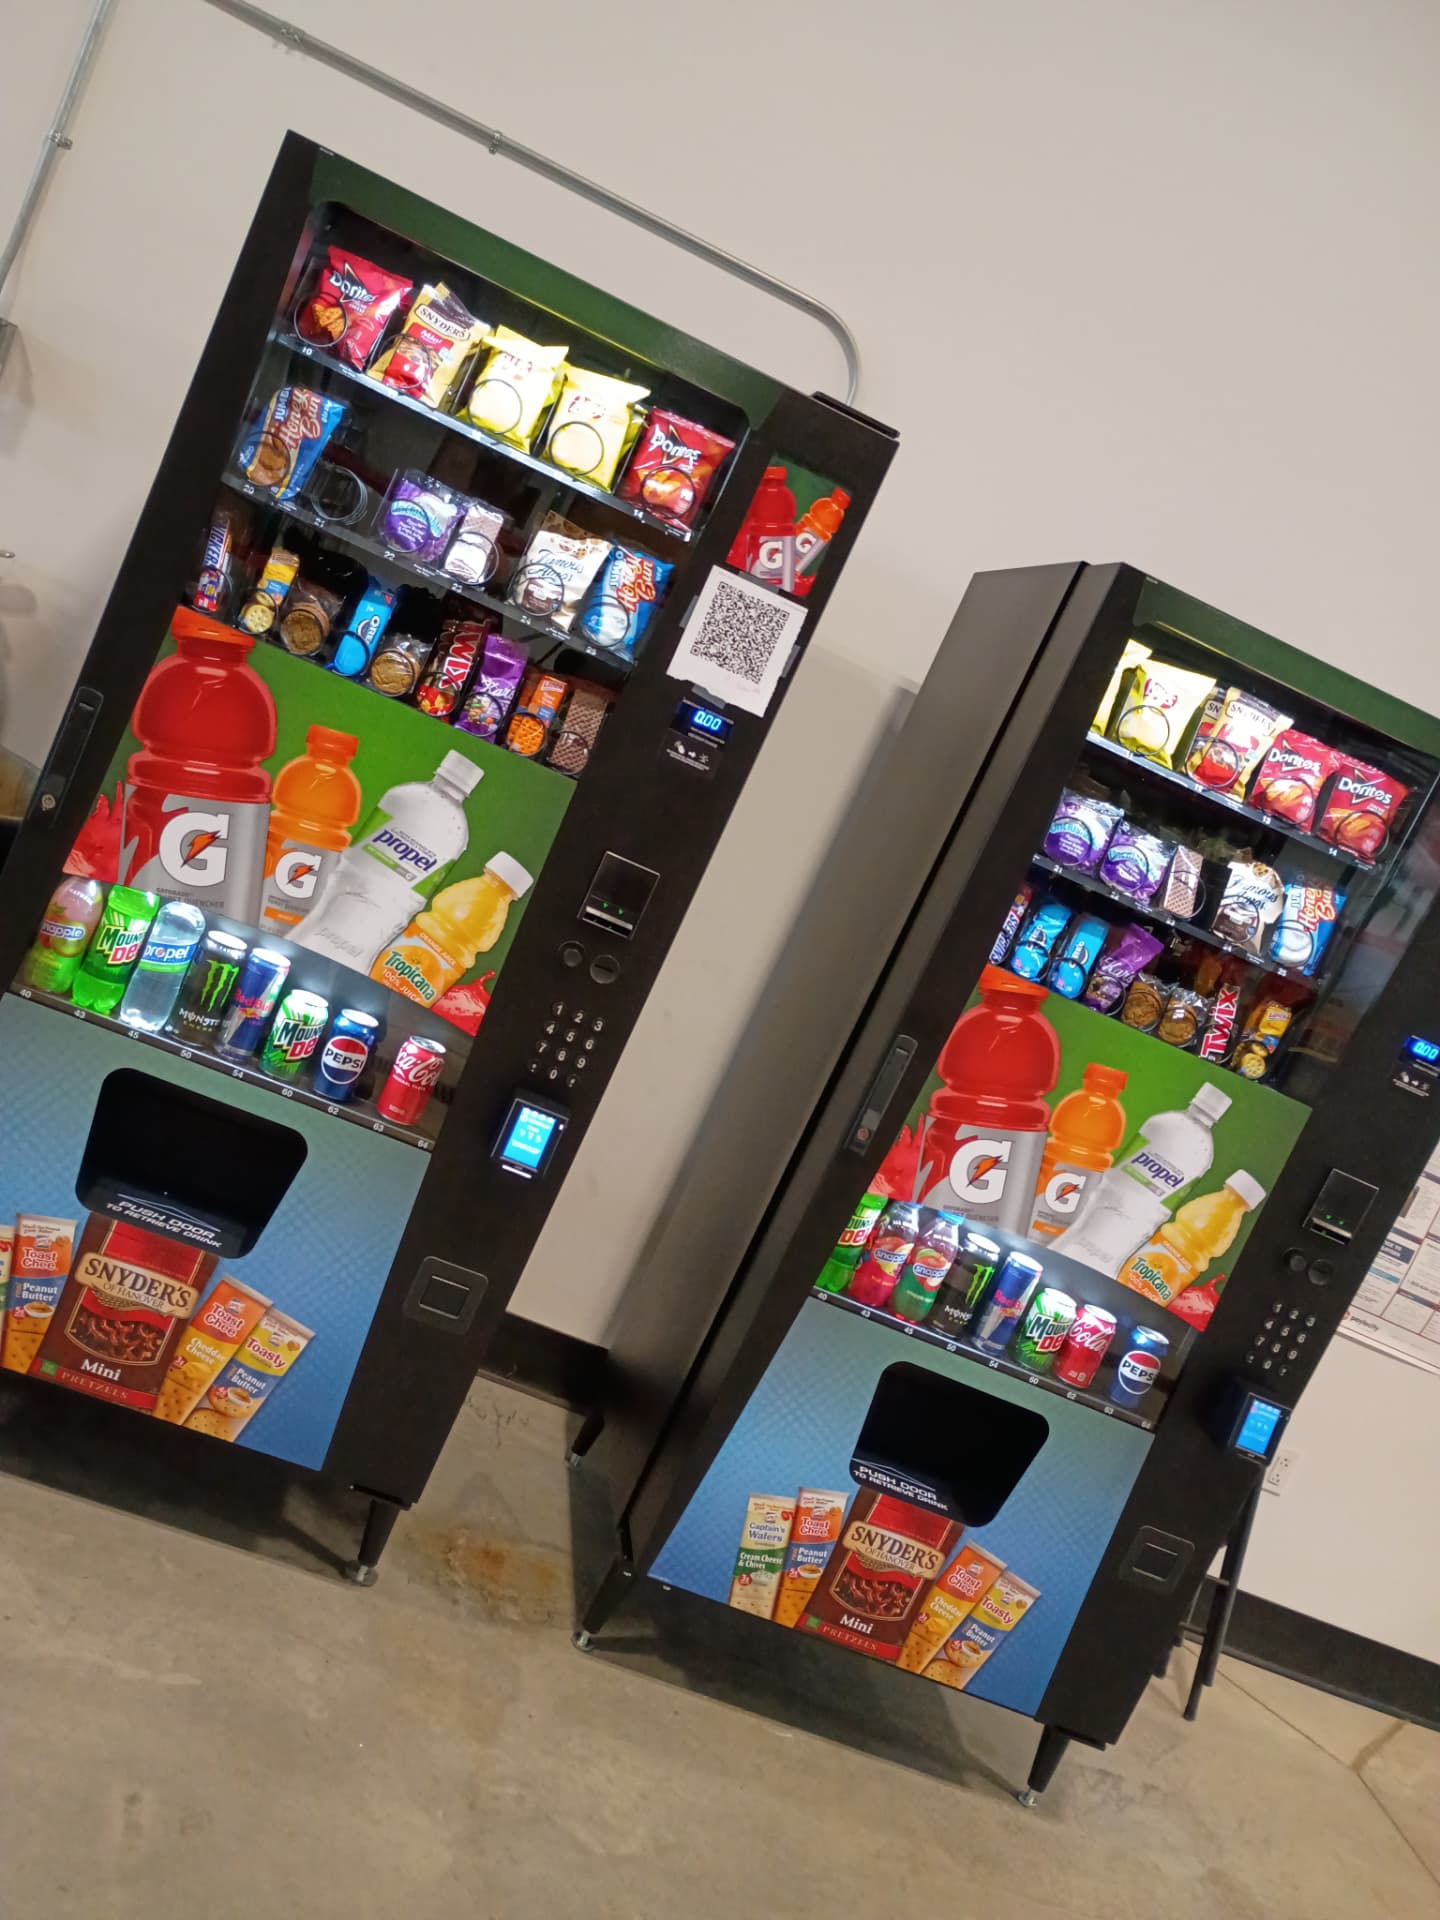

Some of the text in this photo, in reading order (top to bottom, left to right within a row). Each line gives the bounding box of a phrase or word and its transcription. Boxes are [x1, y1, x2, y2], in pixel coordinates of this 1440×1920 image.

[302, 346, 313, 355] 10
[279, 387, 311, 446] Honey
[300, 396, 322, 438] Bun
[795, 531, 817, 554] G
[384, 551, 395, 561] 22
[530, 548, 585, 574] Famous
[759, 540, 784, 569] G
[616, 553, 643, 611] Honey
[634, 560, 656, 601] Bun
[365, 615, 380, 645] ORE
[694, 710, 722, 730] 0.00
[1268, 747, 1321, 776] Doritos
[1338, 776, 1392, 805] Doritos
[159, 812, 230, 887] G
[372, 829, 437, 872] propel
[275, 851, 321, 899] G
[1229, 875, 1279, 903] Famous
[41, 922, 84, 939] napple
[144, 943, 189, 962] propel
[384, 950, 436, 1001] Tropicana
[19, 989, 32, 999] 40
[74, 1009, 87, 1020] 43
[556, 1004, 603, 1031] 1 2 3
[1200, 987, 1239, 1057] TWIX
[128, 1030, 140, 1040] 45
[546, 1024, 594, 1050] 4 5 6
[180, 1050, 192, 1060] 50
[326, 1047, 364, 1069] PEPSI
[539, 1042, 586, 1068] 7 8 9
[232, 1069, 244, 1080] 54
[549, 1069, 558, 1080] 0
[281, 1089, 293, 1098] 60
[327, 1106, 339, 1116] 62
[373, 1123, 385, 1133] 63
[418, 1139, 429, 1149] 64
[949, 1139, 1011, 1204] G
[1131, 1152, 1184, 1188] propel
[1045, 1172, 1087, 1213] G
[106, 1203, 223, 1248] TO RETRIEVE DRINK
[118, 1200, 216, 1240] PUSH DOOR
[22, 1258, 56, 1271] Chee
[23, 1248, 58, 1261] Toast
[22, 1282, 58, 1295] Peanut
[85, 1257, 192, 1308] SNYDER'S
[1130, 1257, 1172, 1301] Tropicana
[22, 1290, 54, 1302] Butter
[103, 1282, 164, 1310] OF HANOVER
[203, 1314, 238, 1338] Chee
[211, 1303, 245, 1330] Toast
[1274, 1303, 1316, 1327] 1 2 3
[1264, 1320, 1306, 1343] 4 5 6
[247, 1338, 287, 1369] Toasty
[1256, 1337, 1297, 1360] 7 8 9
[81, 1358, 122, 1381] Mini
[1264, 1360, 1272, 1369] 0
[61, 1372, 128, 1400] PRETZELS
[232, 1373, 258, 1395] Butter
[236, 1366, 267, 1389] Peanut
[854, 1469, 949, 1511] TO RETRIEVE DRINK
[859, 1466, 937, 1500] PUSH DOOR
[749, 1521, 786, 1536] Captain's
[800, 1525, 828, 1538] Chee
[801, 1517, 830, 1530] Toast
[749, 1529, 783, 1544] Wafers
[852, 1526, 938, 1570] SNYDER'S
[740, 1552, 783, 1566] Cream Cheese
[746, 1559, 766, 1570] Chives
[797, 1554, 824, 1565] Butter
[798, 1547, 828, 1559] Peanut
[876, 1549, 915, 1571] HANOVER
[948, 1575, 975, 1597] Chee
[954, 1566, 981, 1590] Toast
[981, 1596, 1013, 1625] Toasty
[840, 1613, 873, 1635] Mini
[969, 1623, 996, 1645] Peanut
[822, 1625, 878, 1652] PRETZELS
[966, 1629, 988, 1647] Butter
